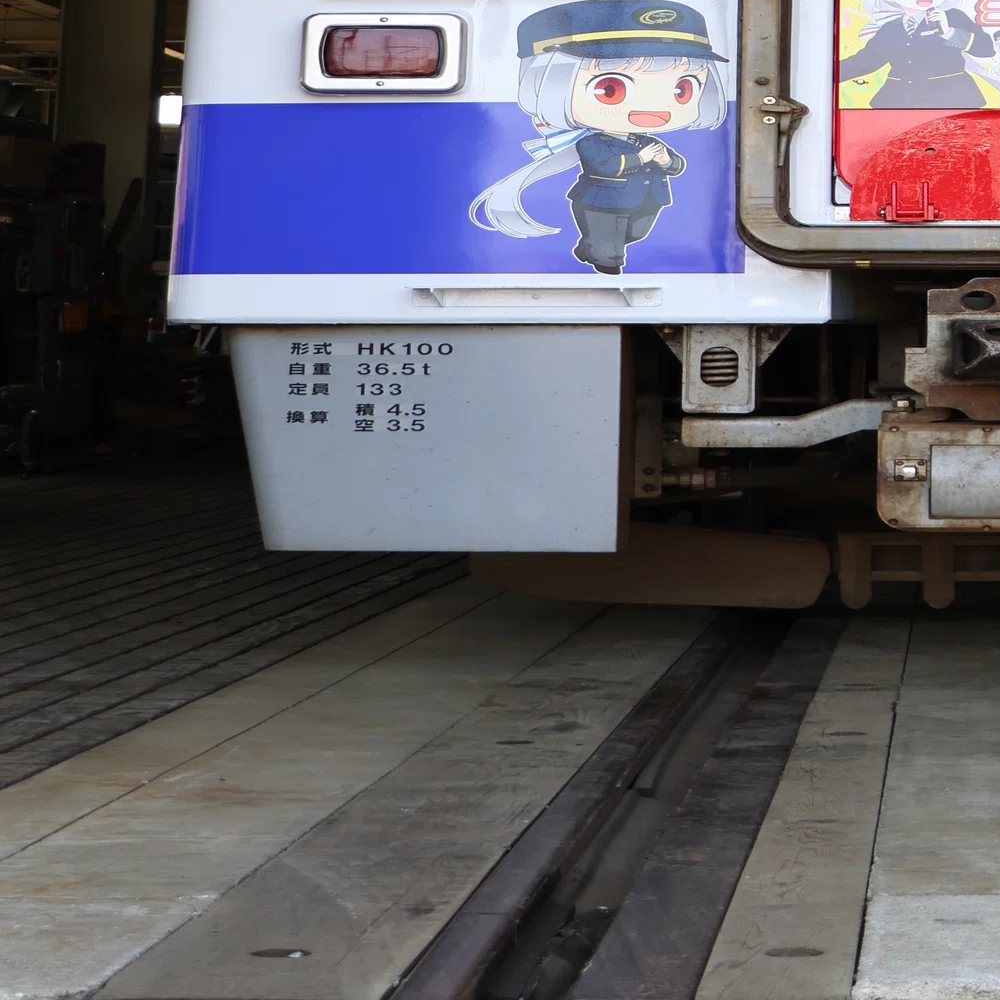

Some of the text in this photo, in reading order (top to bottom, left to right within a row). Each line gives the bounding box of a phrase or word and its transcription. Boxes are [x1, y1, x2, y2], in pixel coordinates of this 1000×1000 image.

[290, 342, 454, 356] 形式 HK100
[288, 362, 431, 376] 自重 36.5t
[288, 382, 403, 396] 定員 133
[355, 403, 426, 416] 積 4.5
[286, 410, 329, 424] 換算
[354, 419, 426, 432] 空 3.5
